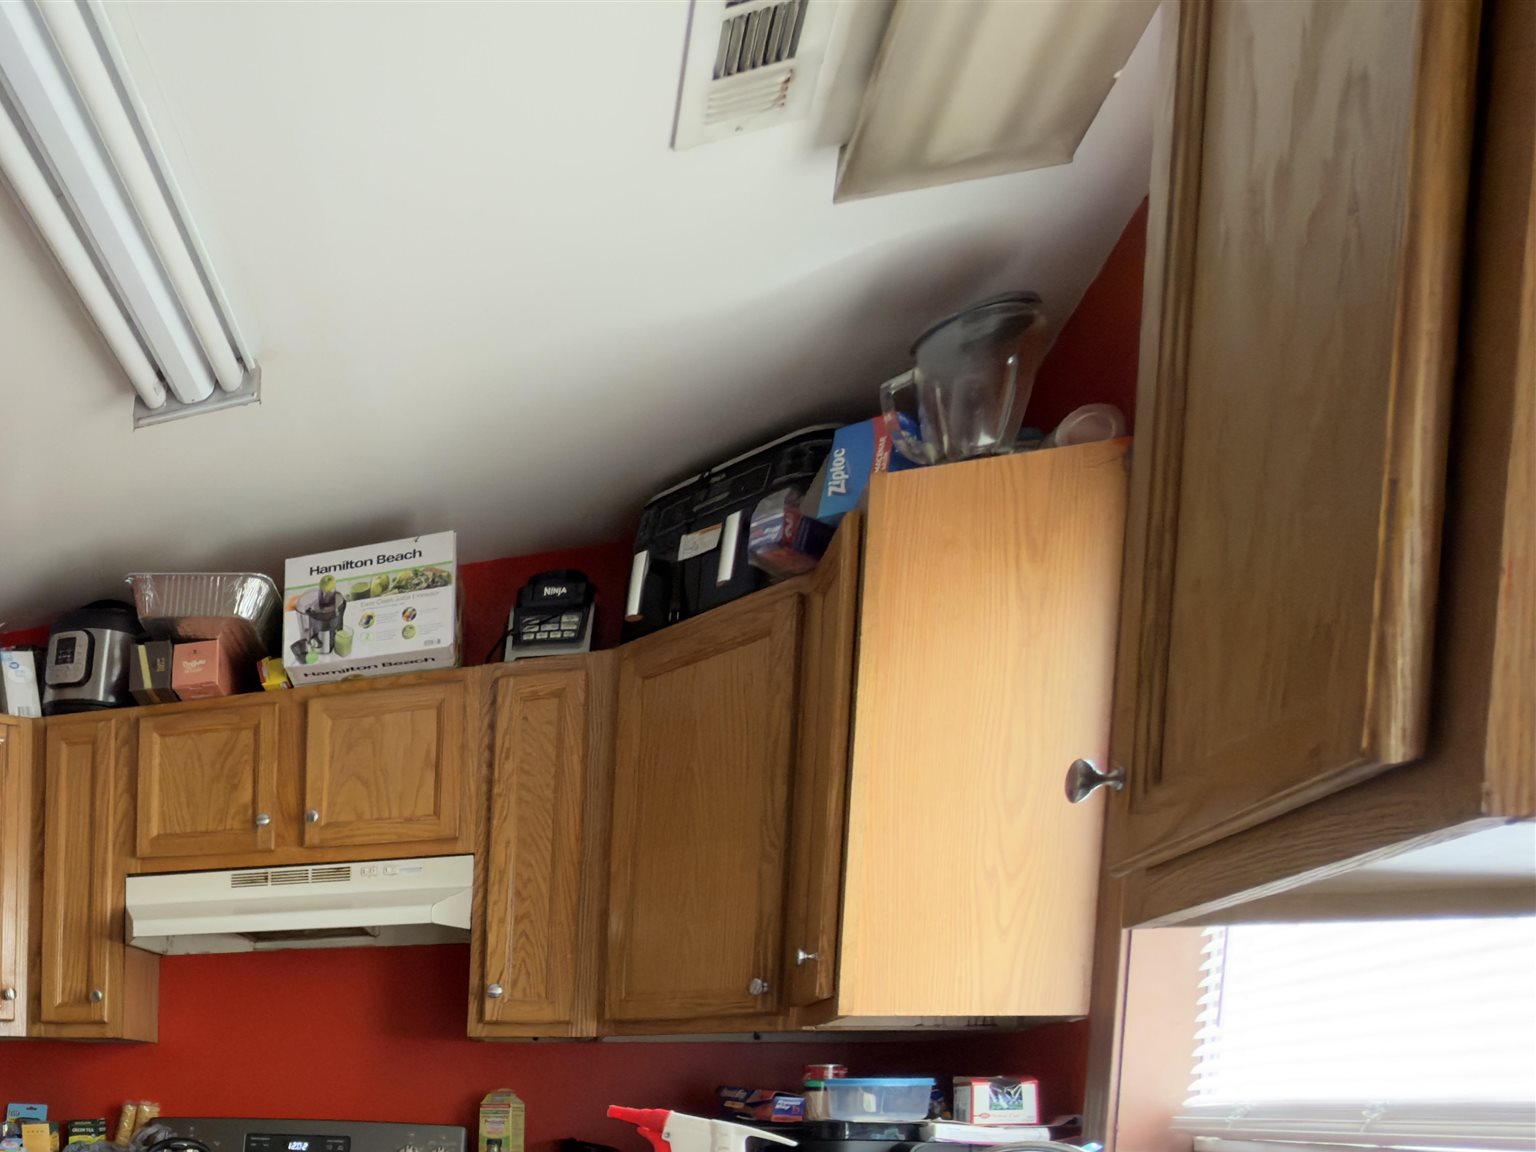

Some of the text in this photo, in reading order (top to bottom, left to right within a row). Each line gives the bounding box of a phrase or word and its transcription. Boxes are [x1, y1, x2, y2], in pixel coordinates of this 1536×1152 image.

[827, 447, 850, 497] Ziploc
[309, 549, 423, 577] Hamilton Beach
[543, 586, 567, 597] NINJA
[303, 656, 436, 678] Hamilton Beach
